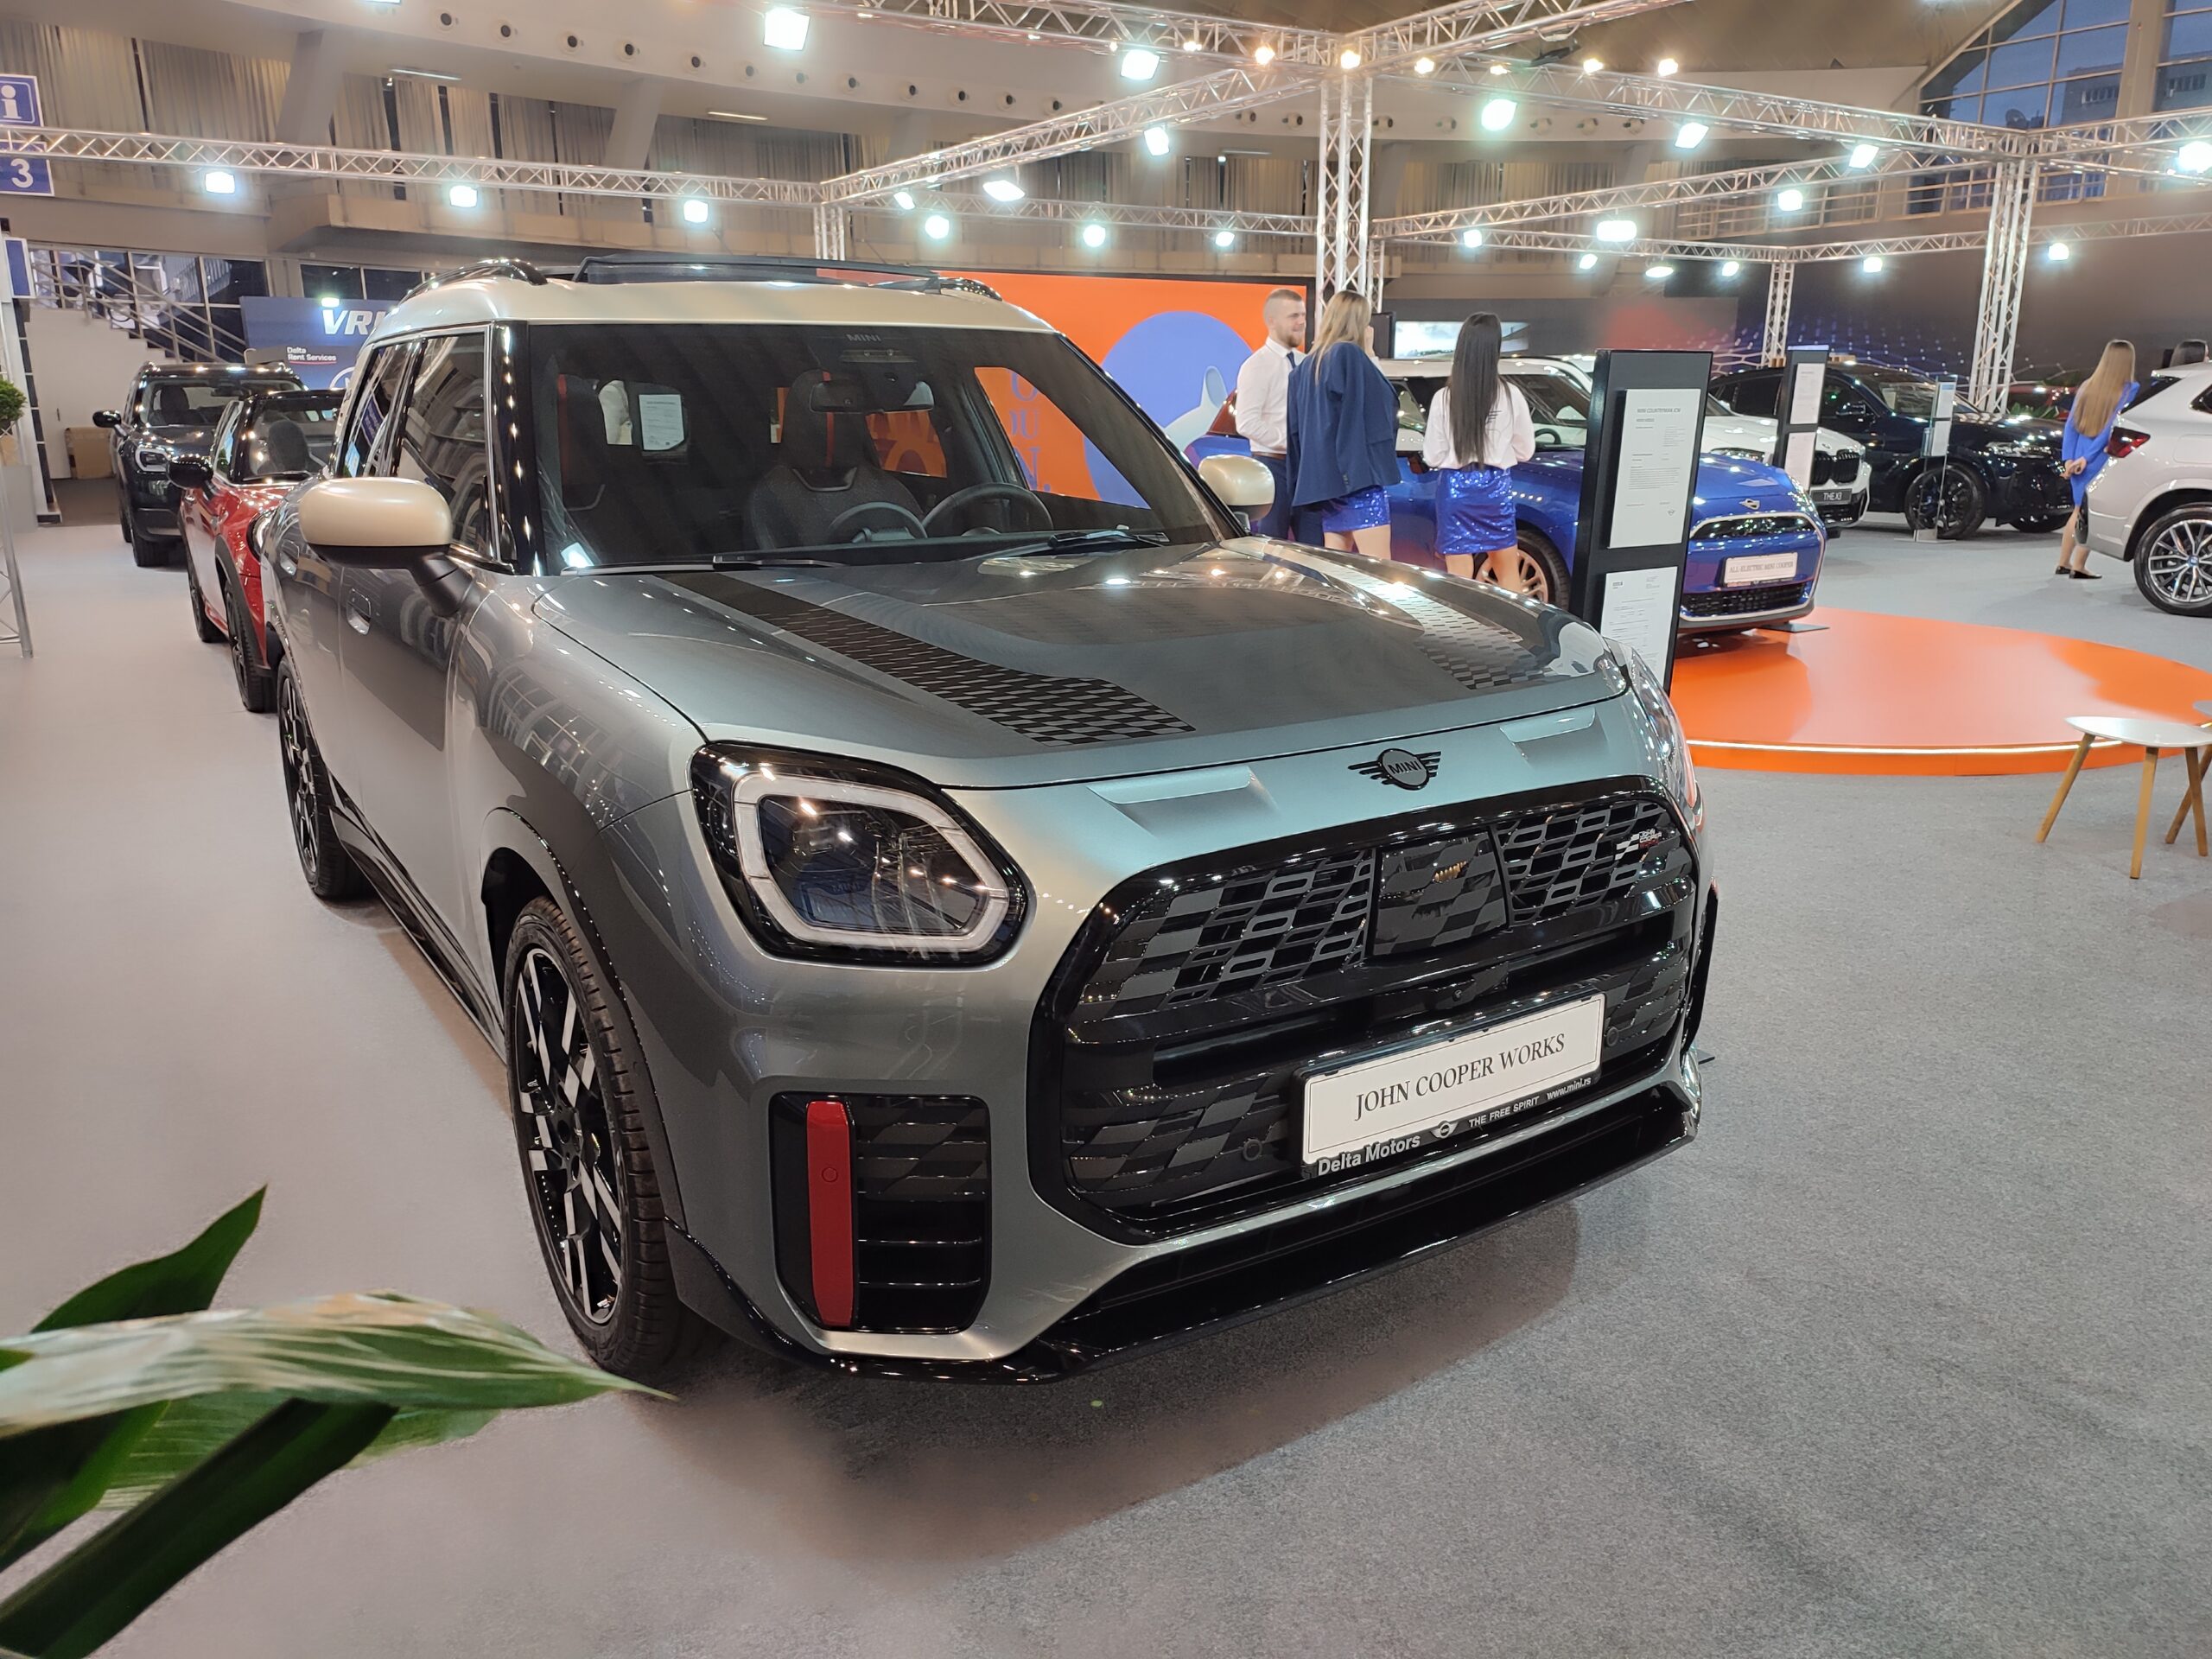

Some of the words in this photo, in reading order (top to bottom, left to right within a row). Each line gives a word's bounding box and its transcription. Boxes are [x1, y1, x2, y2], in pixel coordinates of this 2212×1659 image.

[10, 158, 34, 188] 3
[1823, 492, 1835, 501] THE
[1388, 760, 1422, 774] MINI
[1354, 1080, 1410, 1122] JOHN
[1415, 1056, 1495, 1096] COOPER
[1499, 1033, 1565, 1070] WORKS
[1469, 1115, 1487, 1128] THE
[1489, 1106, 1511, 1122] FREE
[1513, 1096, 1540, 1112] SPIRIT
[1546, 1077, 1592, 1100] www.mini.rs
[1318, 1152, 1362, 1176] Delta
[1365, 1135, 1421, 1162] Motors
